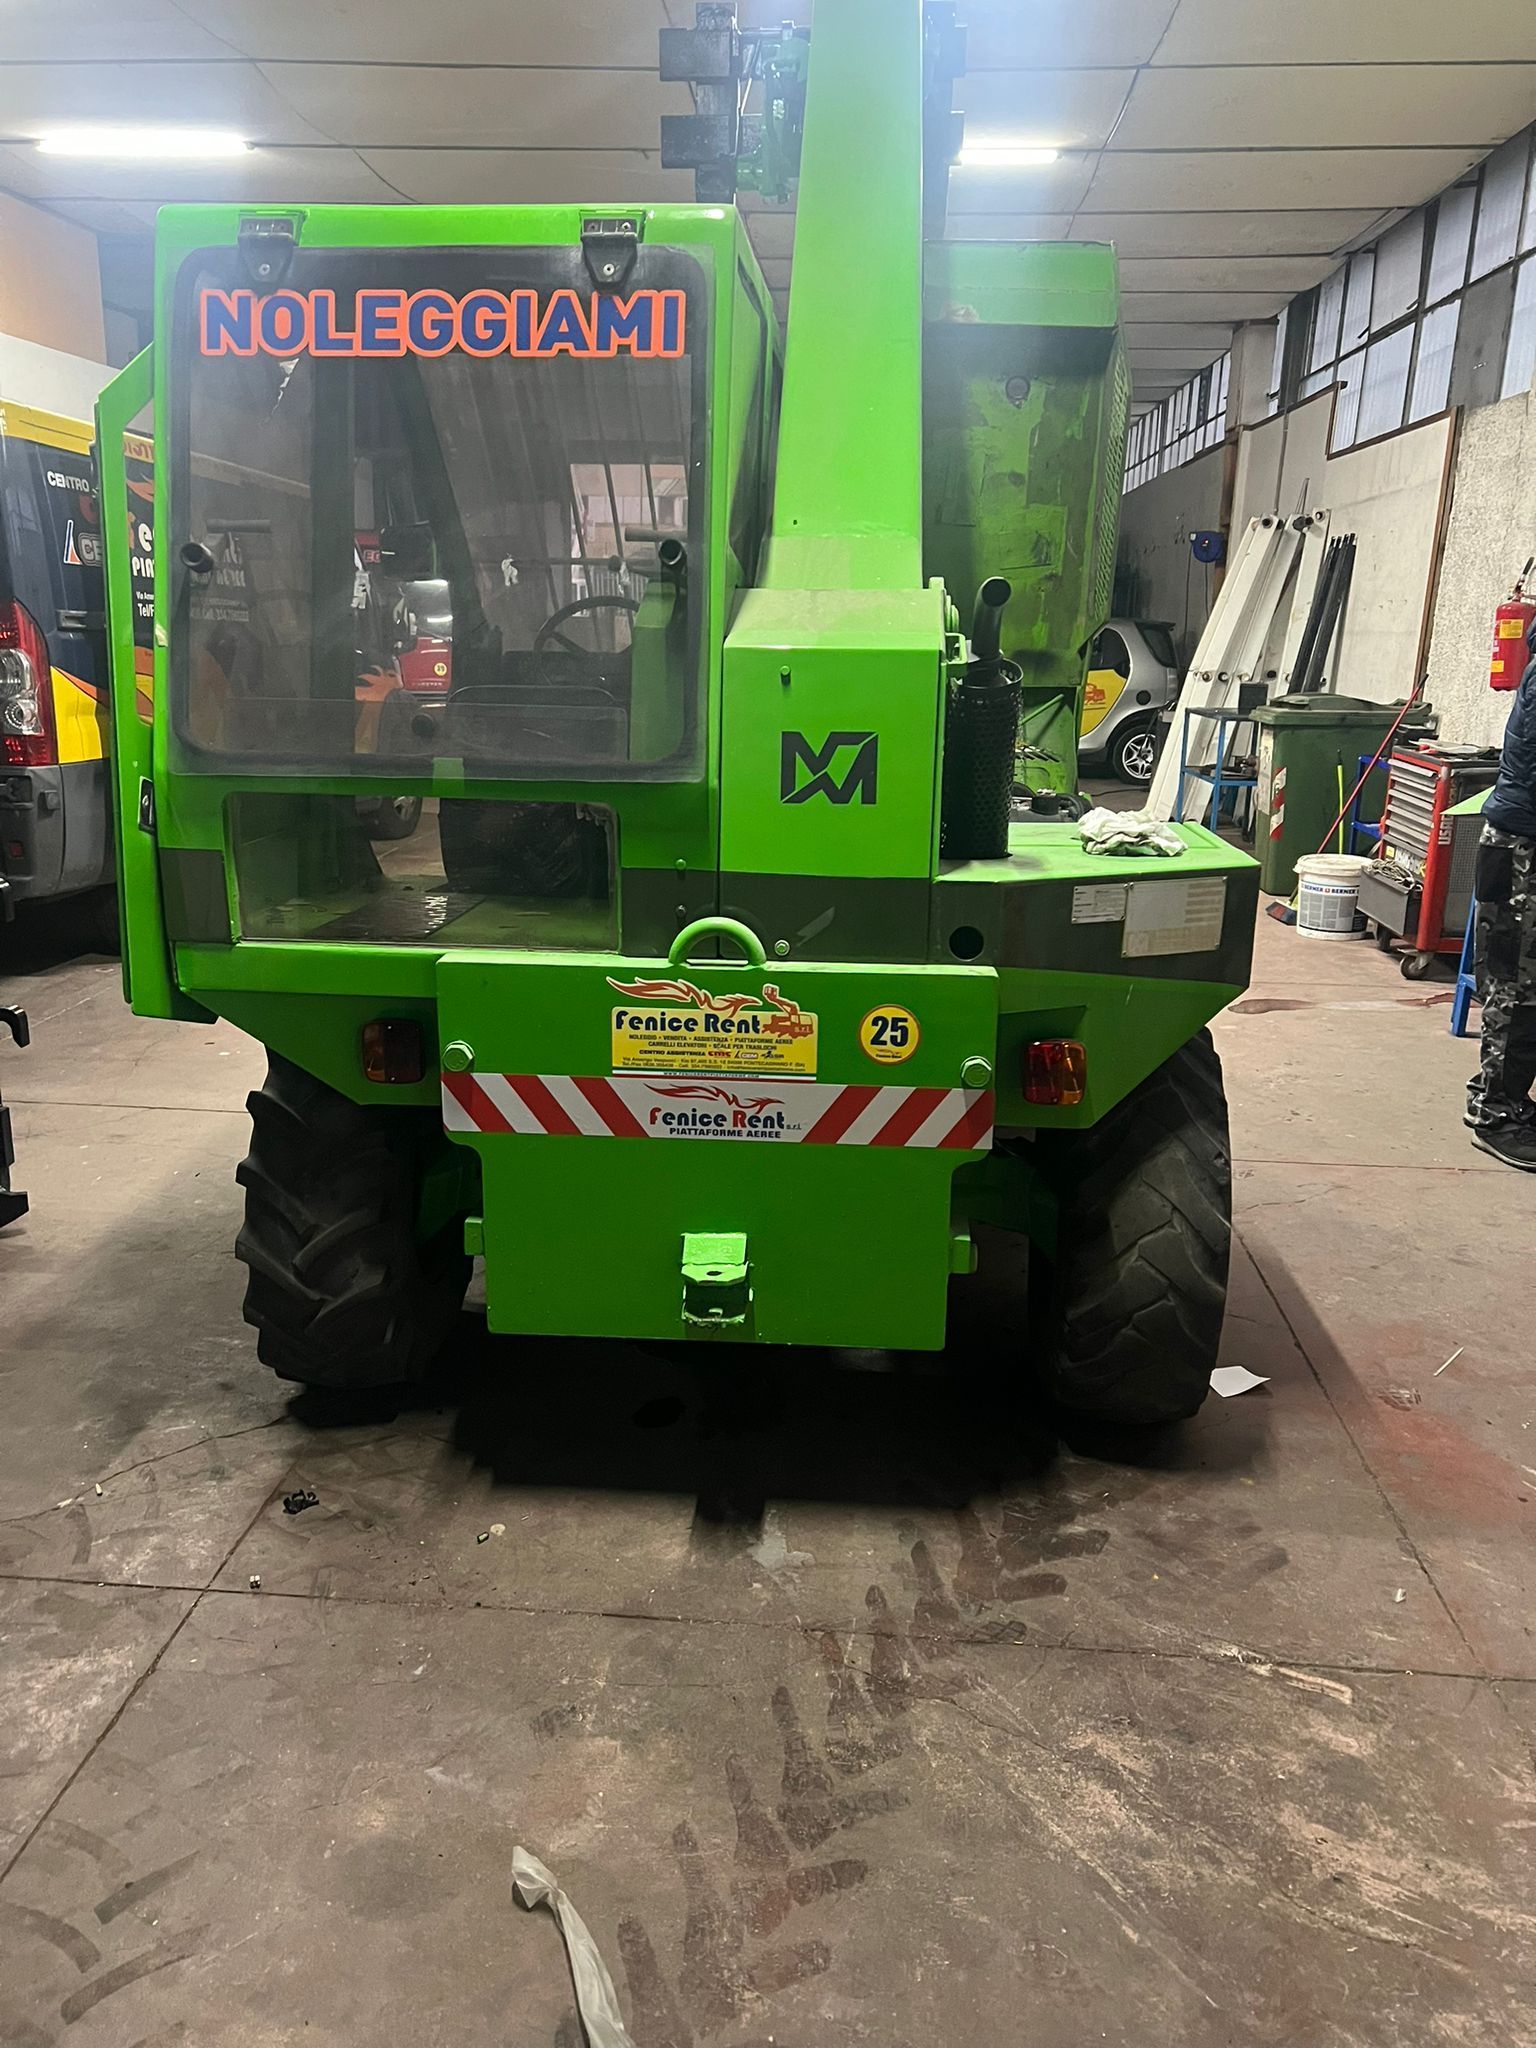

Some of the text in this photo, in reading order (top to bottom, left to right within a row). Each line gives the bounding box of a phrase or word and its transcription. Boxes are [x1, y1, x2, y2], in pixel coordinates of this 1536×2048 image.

[200, 289, 687, 357] NOLEGGIAMI
[47, 470, 90, 492] CENTRO
[131, 556, 154, 578] PIA
[616, 1010, 698, 1032] Fenice
[704, 1013, 760, 1034] Rent
[870, 1015, 909, 1047] 25
[650, 1107, 727, 1127] Fenice
[732, 1110, 785, 1129] Rent
[669, 1127, 781, 1138] PIATTAFORME AEREE
